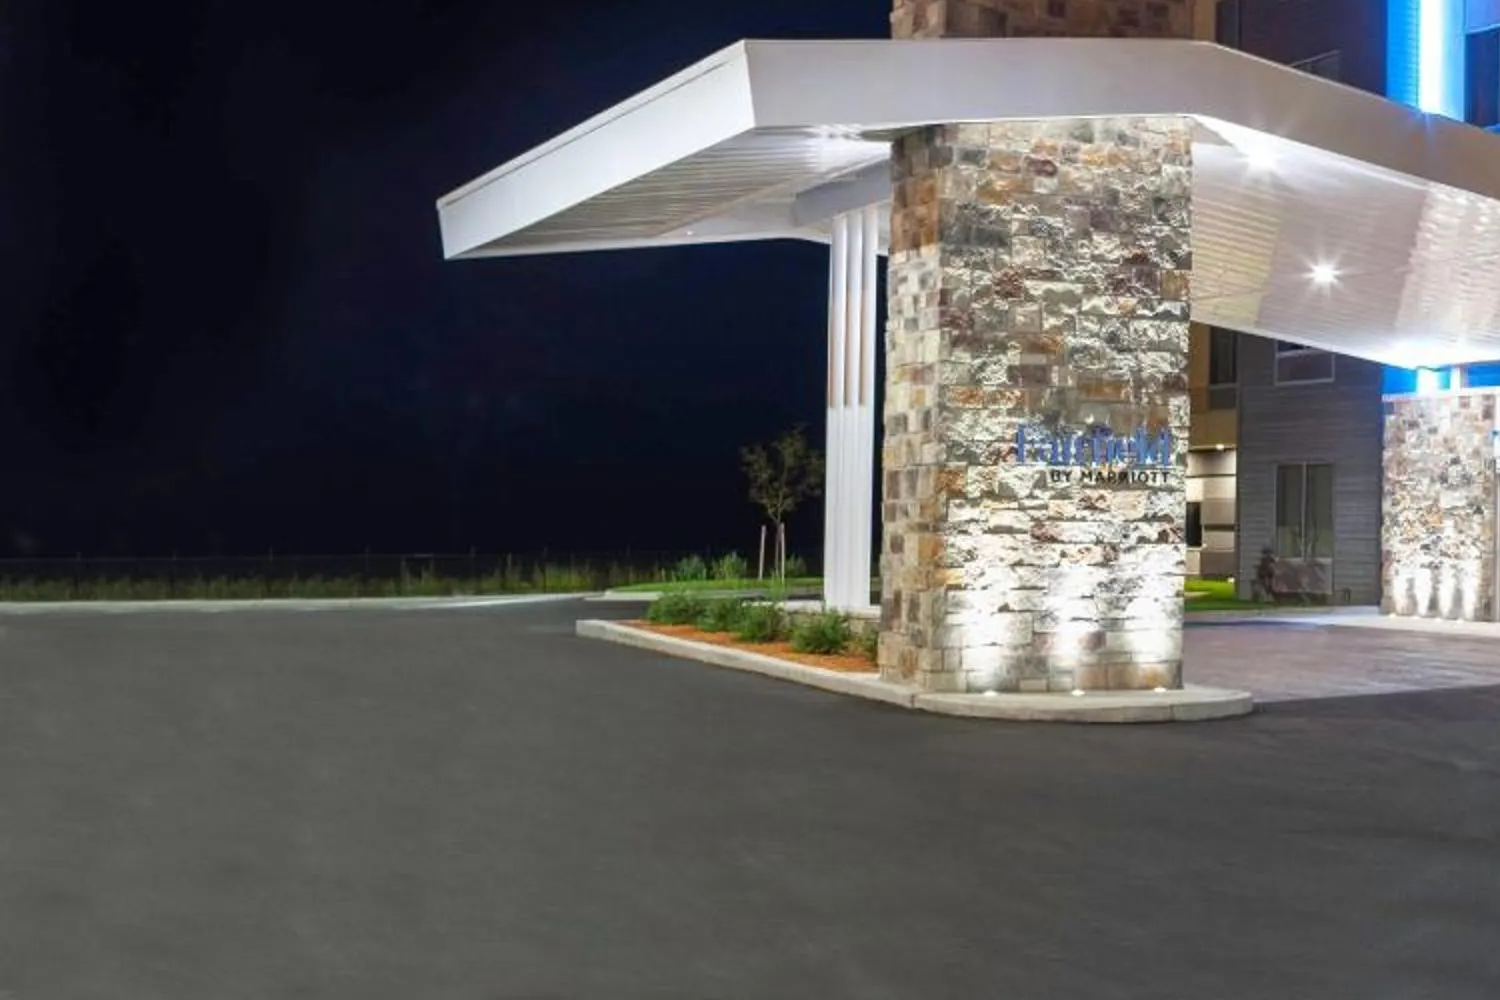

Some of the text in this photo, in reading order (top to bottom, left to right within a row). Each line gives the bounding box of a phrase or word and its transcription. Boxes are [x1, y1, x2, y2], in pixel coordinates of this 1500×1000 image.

[1016, 423, 1172, 467] Fairfield
[1050, 470, 1170, 483] BY MARRIOTT
